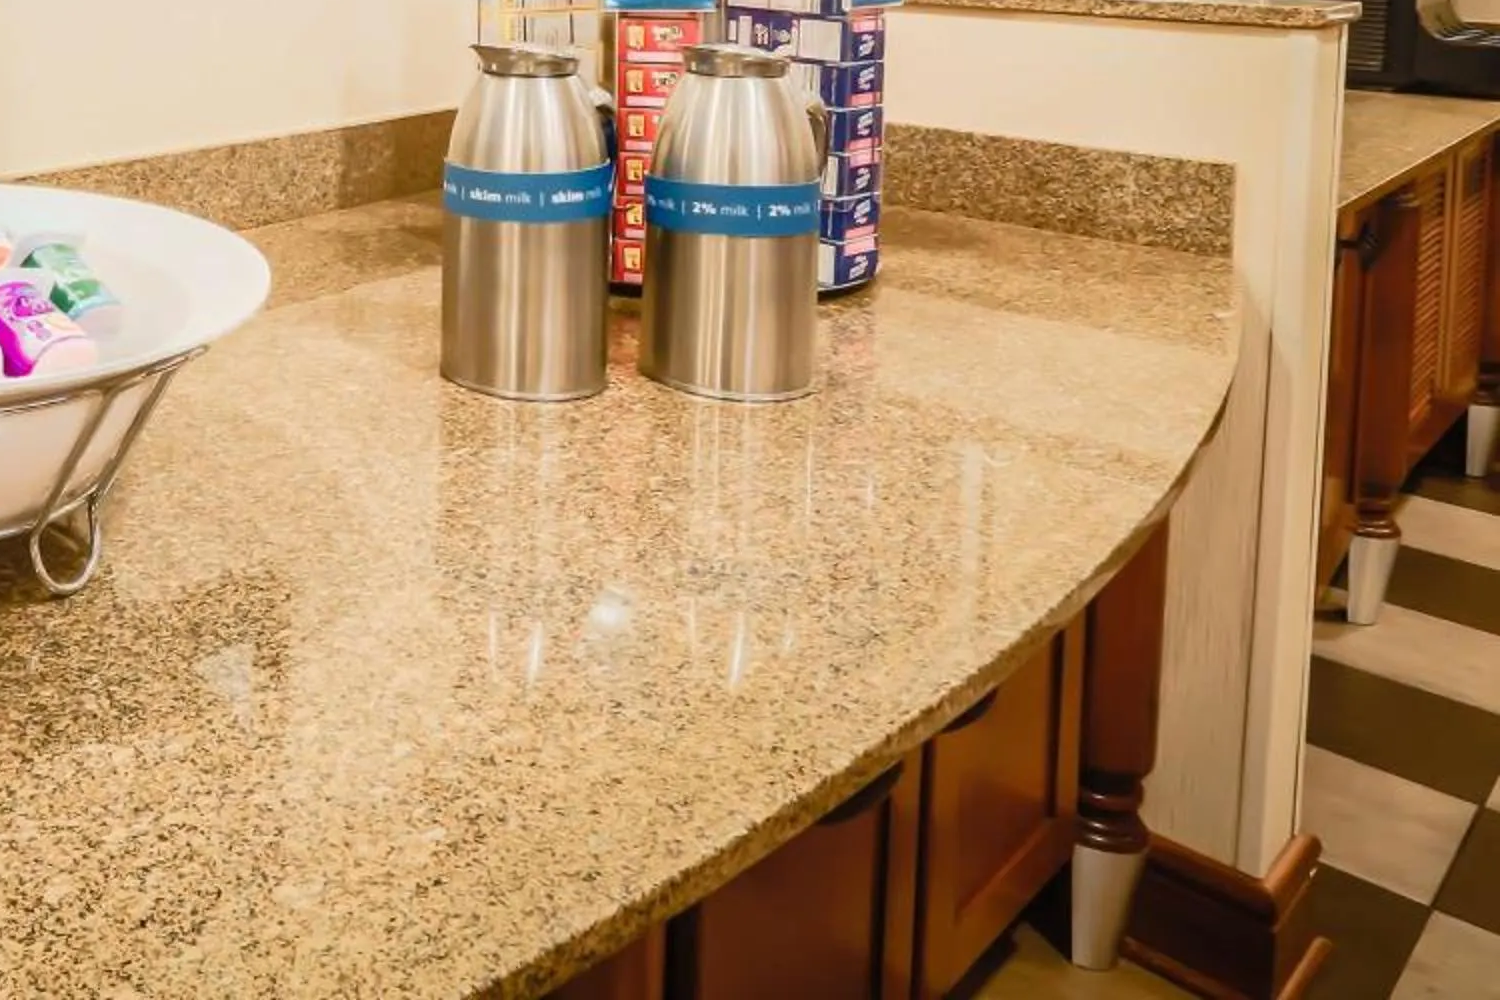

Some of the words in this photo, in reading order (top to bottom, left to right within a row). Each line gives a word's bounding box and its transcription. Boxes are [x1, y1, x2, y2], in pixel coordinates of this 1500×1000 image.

[469, 187, 501, 202] skim
[505, 191, 531, 205] milk
[552, 189, 585, 204] skim
[692, 201, 717, 215] 2%
[720, 204, 749, 217] milk
[769, 204, 792, 217] 2%
